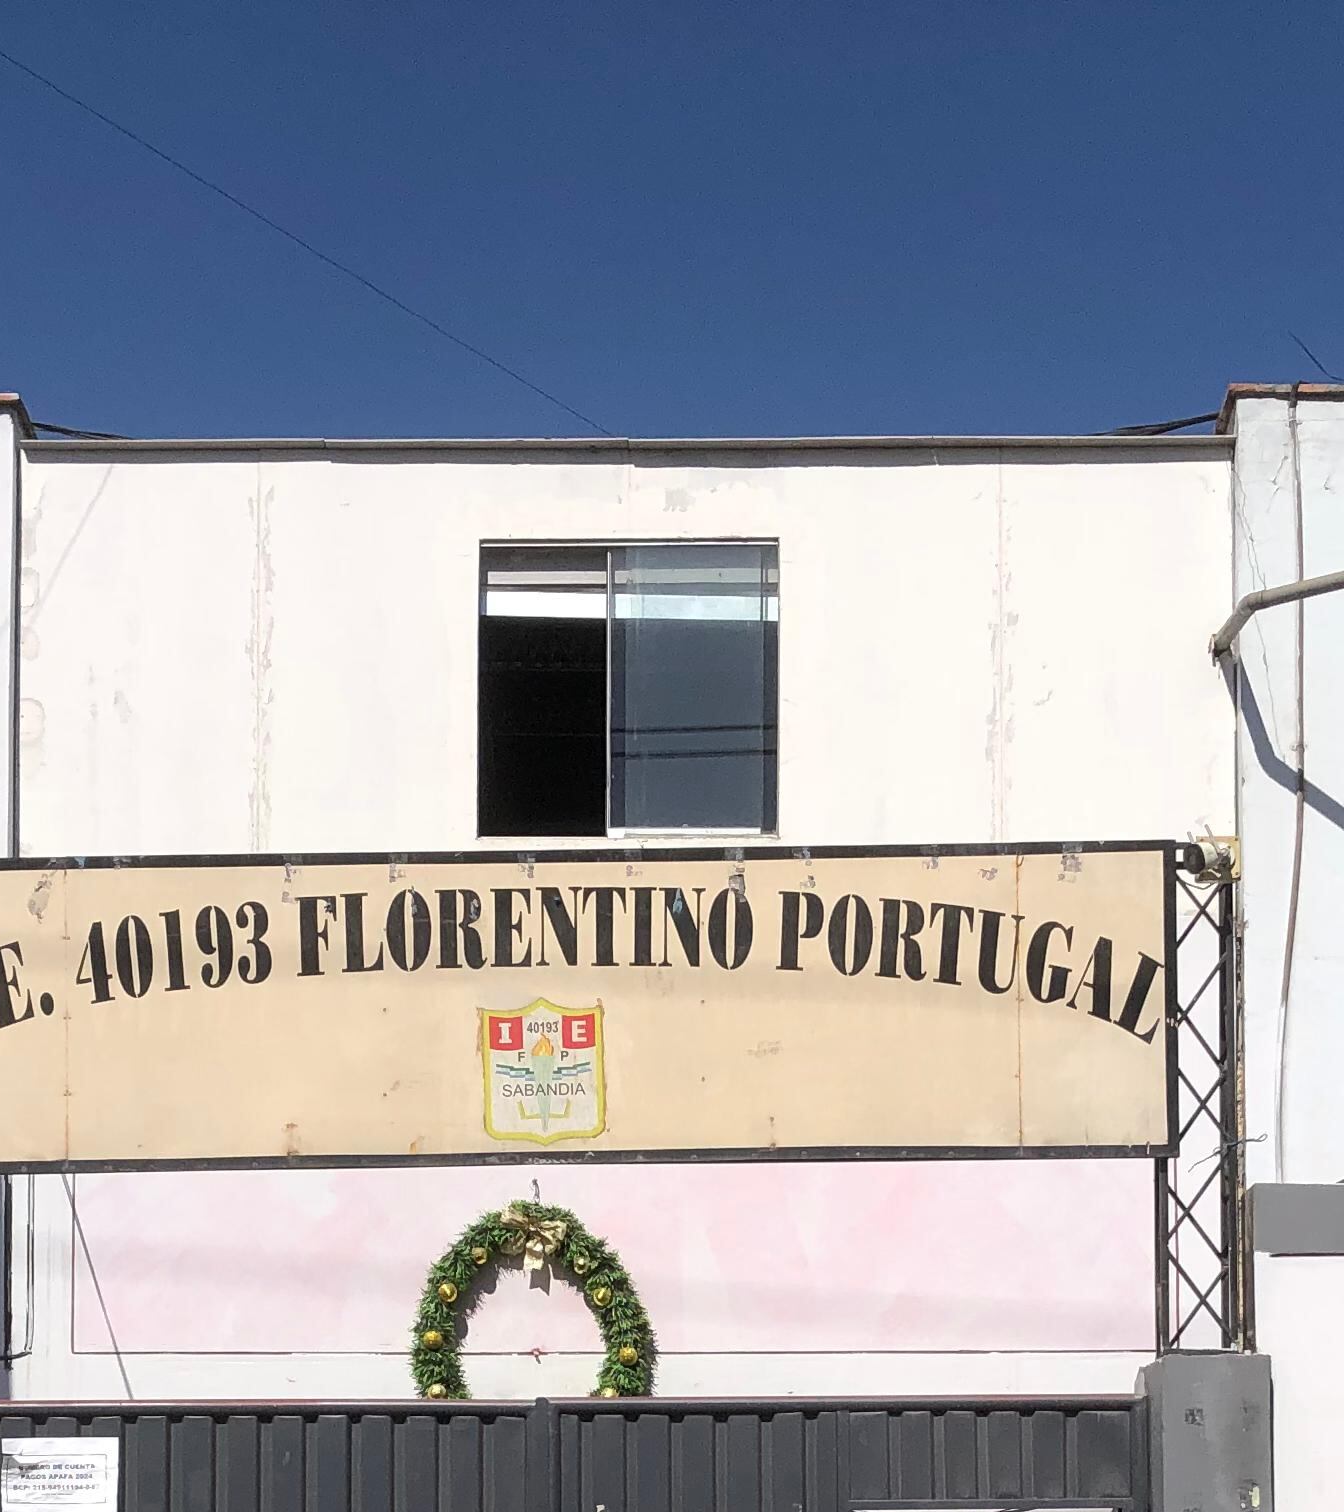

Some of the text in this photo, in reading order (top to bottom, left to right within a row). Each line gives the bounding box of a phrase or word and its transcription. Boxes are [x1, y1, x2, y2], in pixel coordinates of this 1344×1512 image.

[75, 901, 272, 1004] 40193
[294, 886, 754, 977] FLORENTINO
[775, 890, 1165, 1045] PORTUGAL
[497, 1020, 588, 1044] I 40193 E
[517, 1050, 569, 1062] F P
[502, 1083, 586, 1098] SABANDIA
